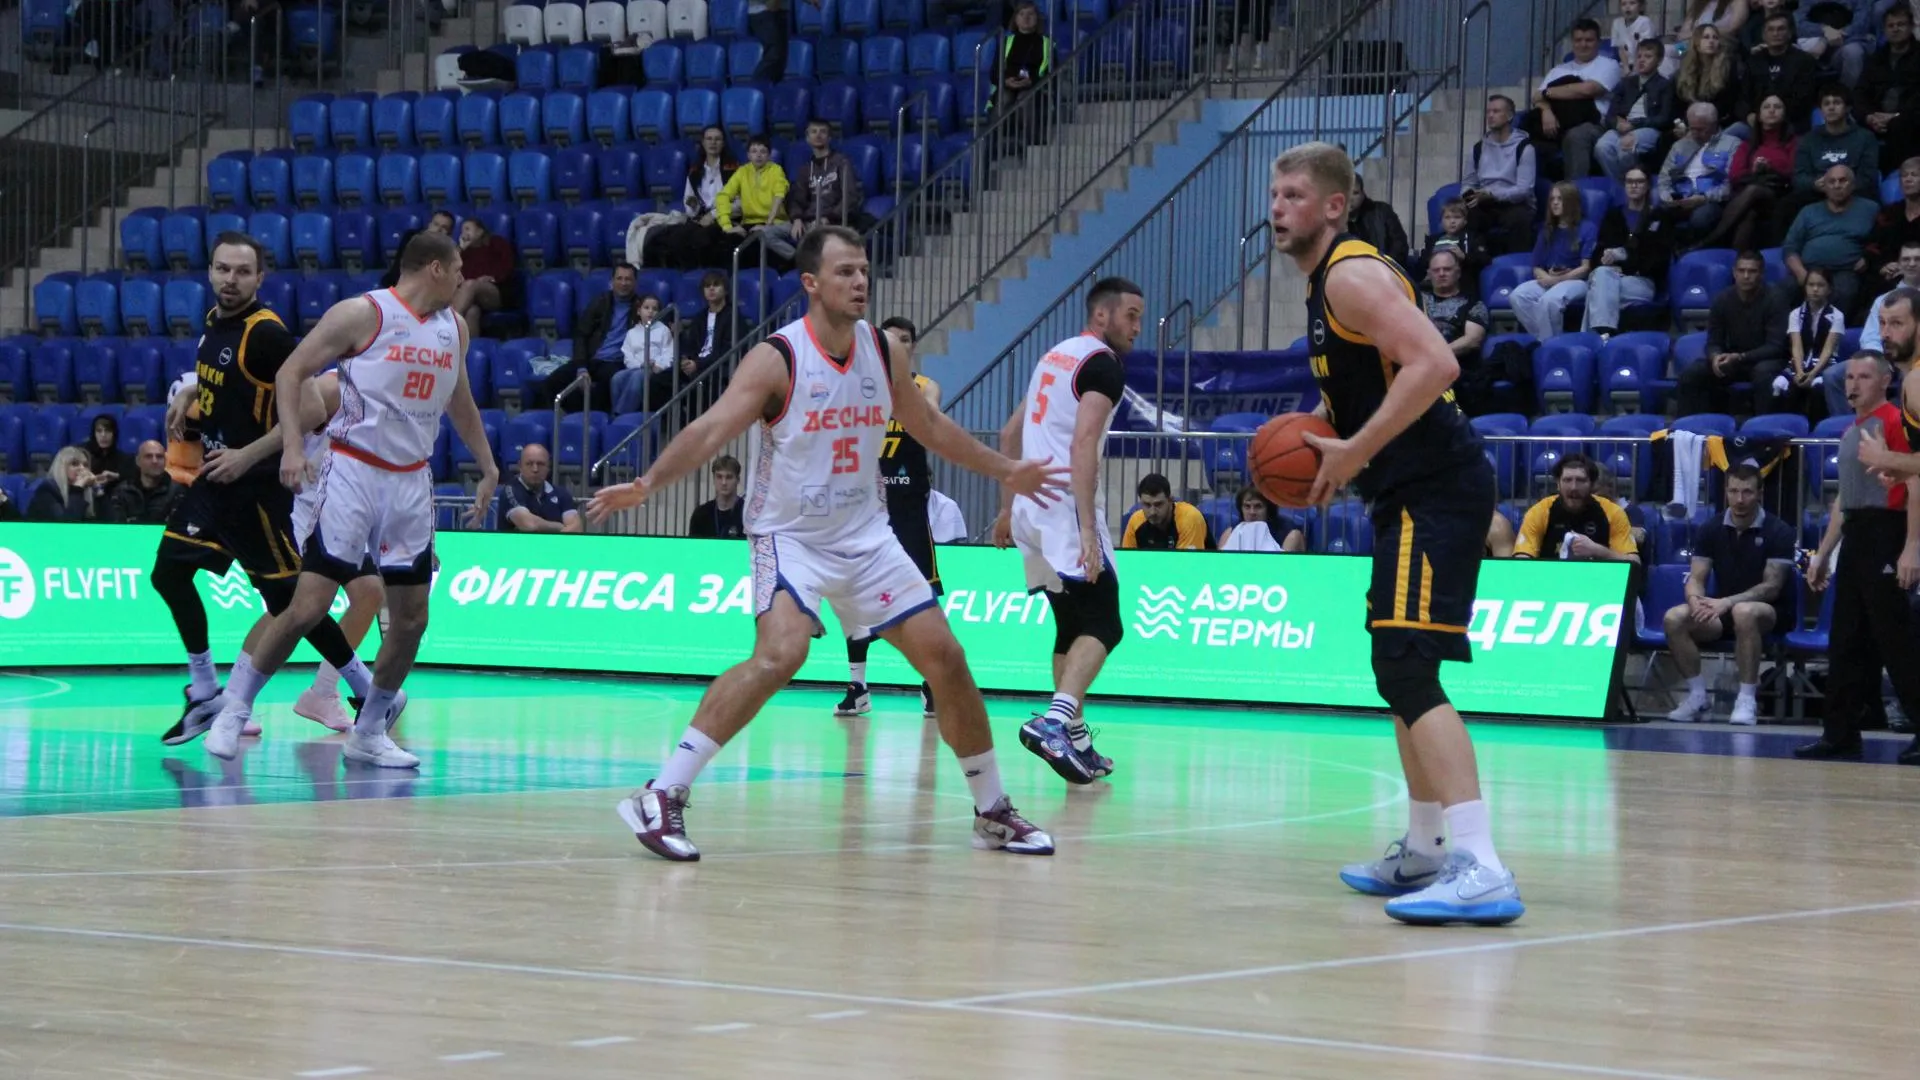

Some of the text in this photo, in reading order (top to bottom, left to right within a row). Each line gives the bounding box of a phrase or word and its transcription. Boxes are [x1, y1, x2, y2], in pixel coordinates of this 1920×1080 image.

[385, 345, 453, 370] ДЕСНА
[402, 371, 436, 400] 20
[1032, 372, 1056, 424] 5
[803, 405, 885, 433] ДЕСНА
[832, 437, 860, 475] 25
[44, 566, 142, 600] FLYFIT
[449, 565, 676, 612] ФИТНЕСА
[1190, 583, 1289, 613] АЭРО
[944, 590, 1050, 625] FLYFIT
[1188, 617, 1315, 649] ТЕРМЫ
